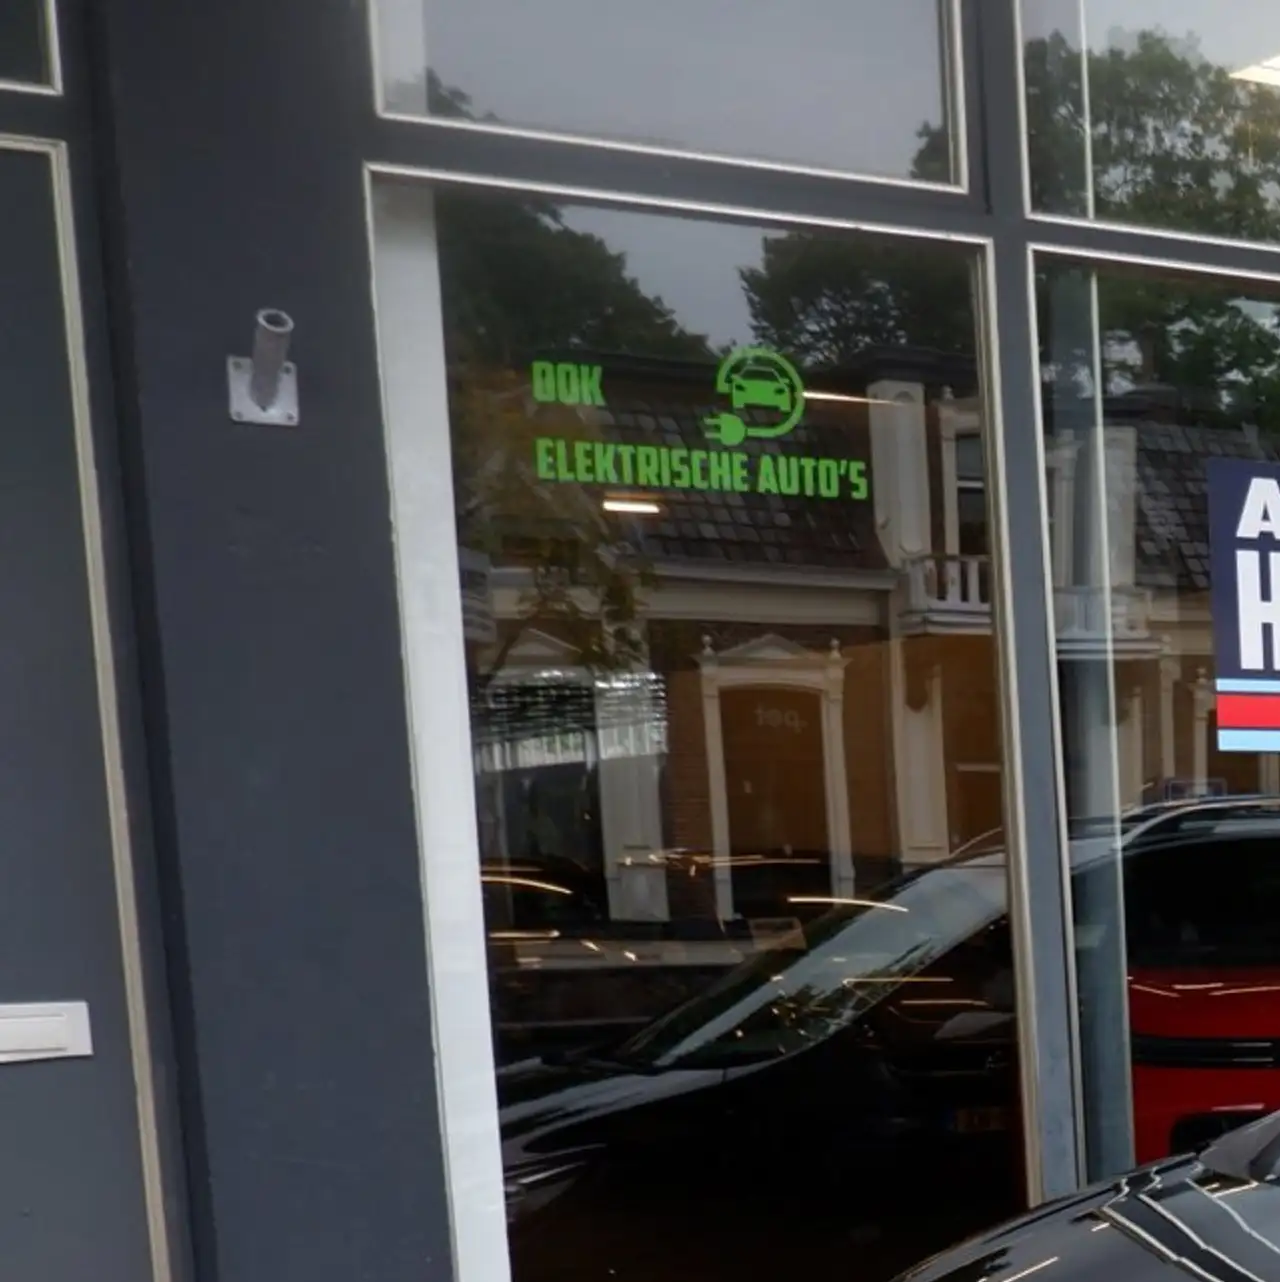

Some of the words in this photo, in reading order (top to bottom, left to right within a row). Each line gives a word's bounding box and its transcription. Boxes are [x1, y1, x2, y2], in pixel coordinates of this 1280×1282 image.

[533, 361, 606, 406] OOK
[536, 438, 751, 493] ELEKTRISCHE
[757, 456, 869, 501] AUTO'S
